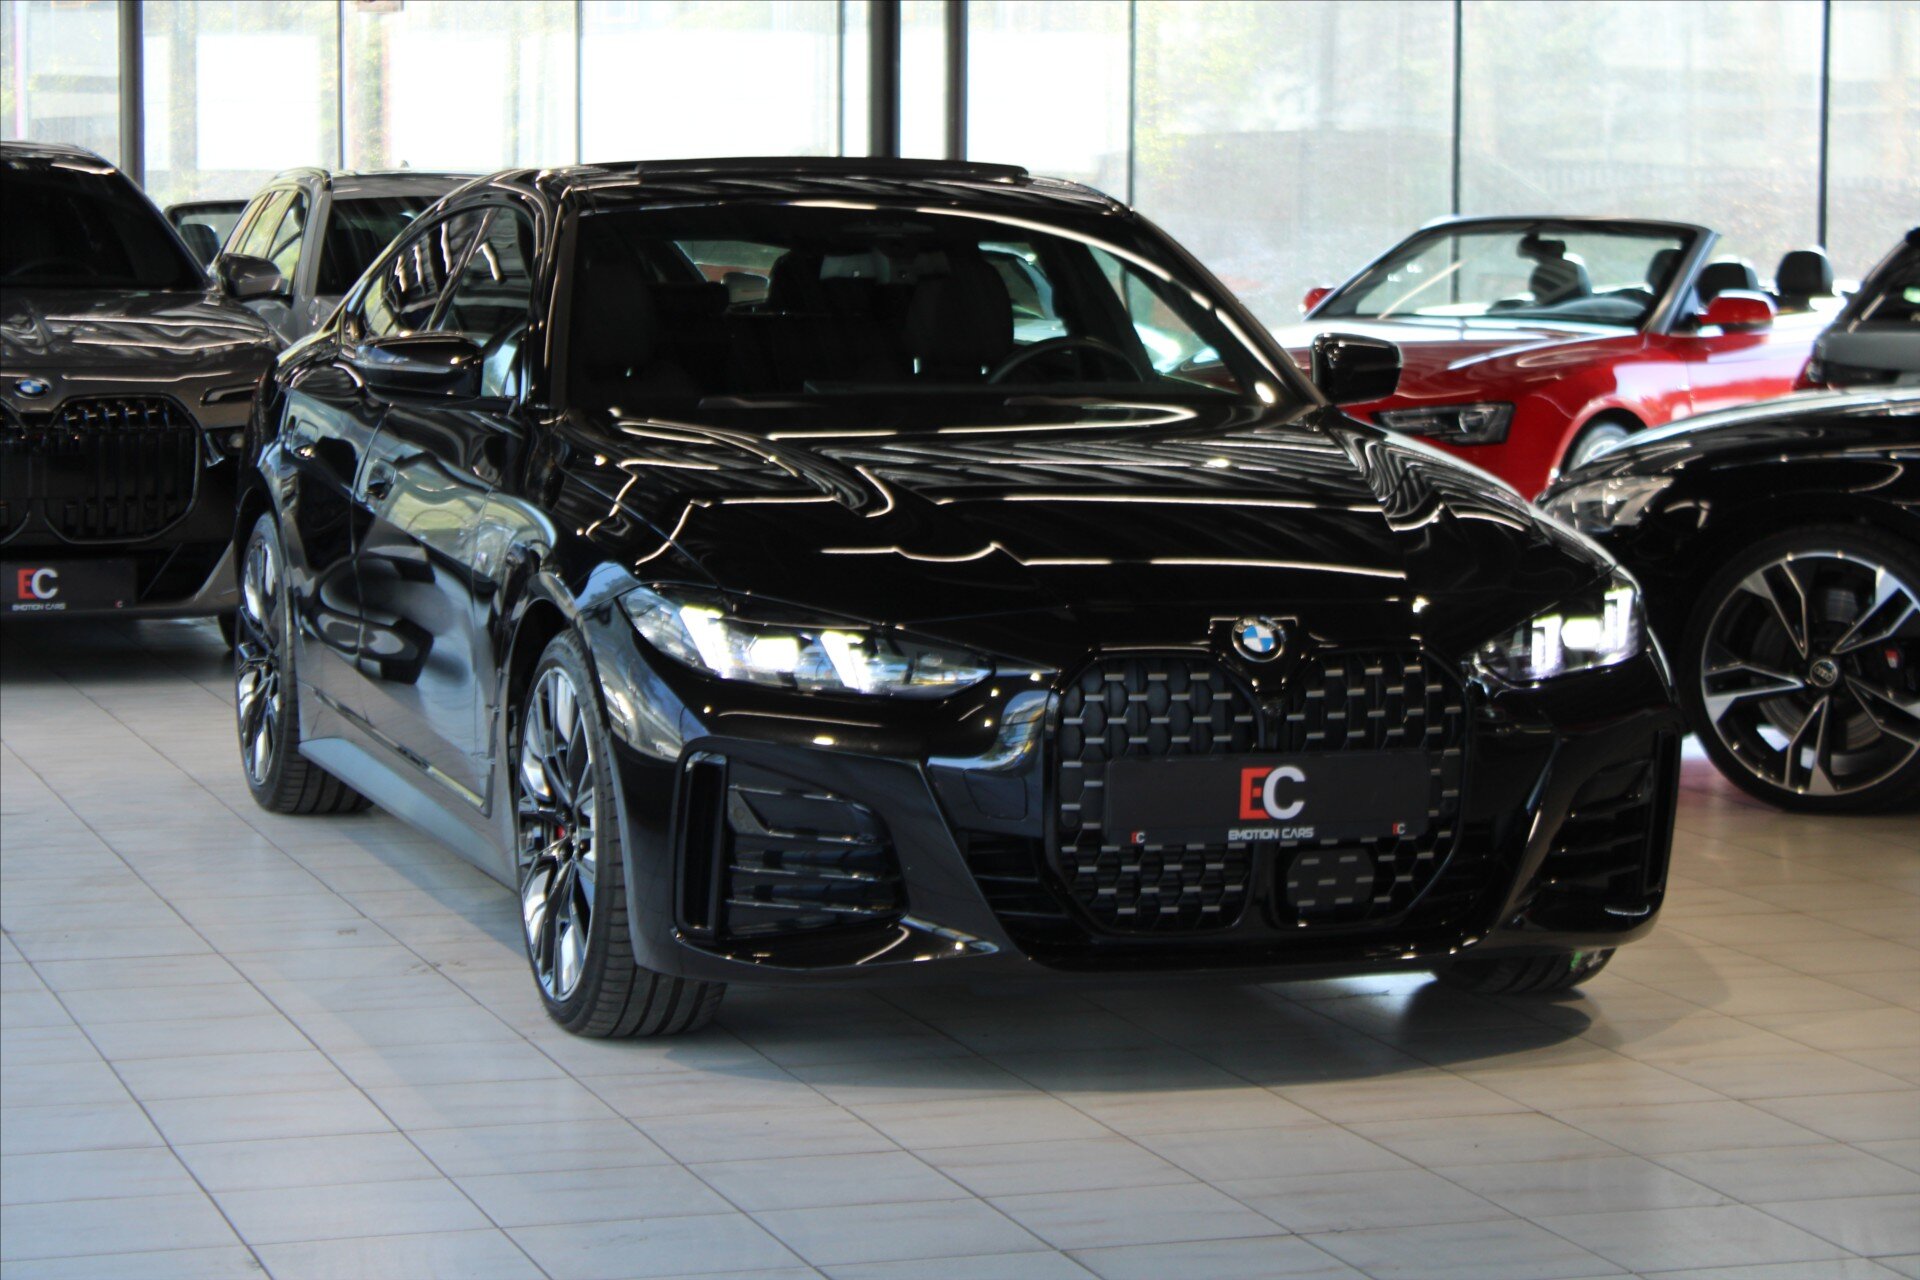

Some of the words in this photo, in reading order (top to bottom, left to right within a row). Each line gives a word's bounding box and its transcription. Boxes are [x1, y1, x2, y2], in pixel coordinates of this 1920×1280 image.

[17, 568, 58, 599] EC
[12, 603, 44, 611] EMOTION
[45, 602, 66, 610] CARS
[1239, 766, 1306, 820] EC
[1228, 828, 1279, 841] EMOTION
[1282, 827, 1314, 839] CARS
